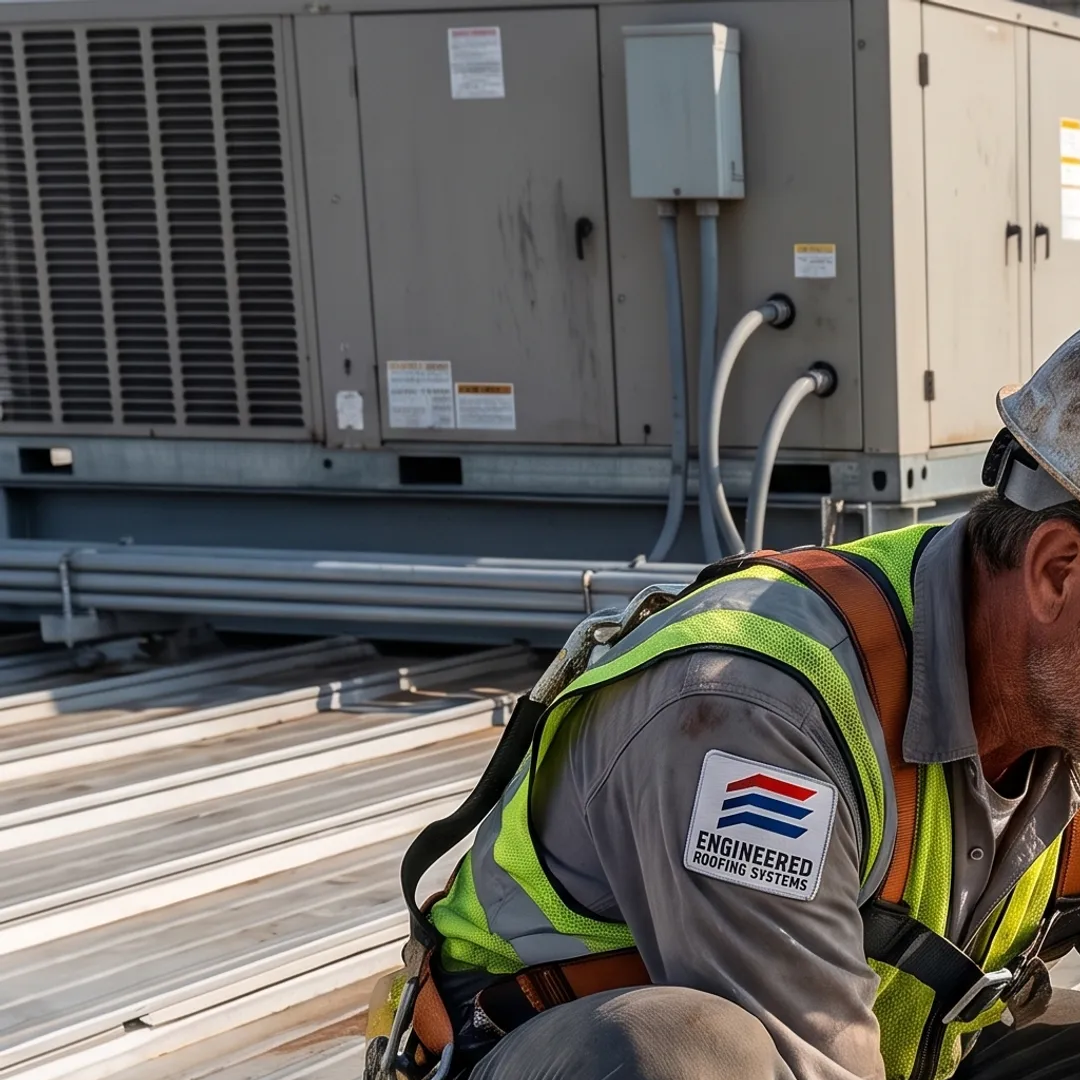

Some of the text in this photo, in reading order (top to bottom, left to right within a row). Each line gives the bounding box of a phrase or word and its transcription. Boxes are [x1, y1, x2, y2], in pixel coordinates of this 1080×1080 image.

[693, 850, 808, 891] ROOFING SYSTEMS
[696, 830, 813, 877] ENGINEERED
